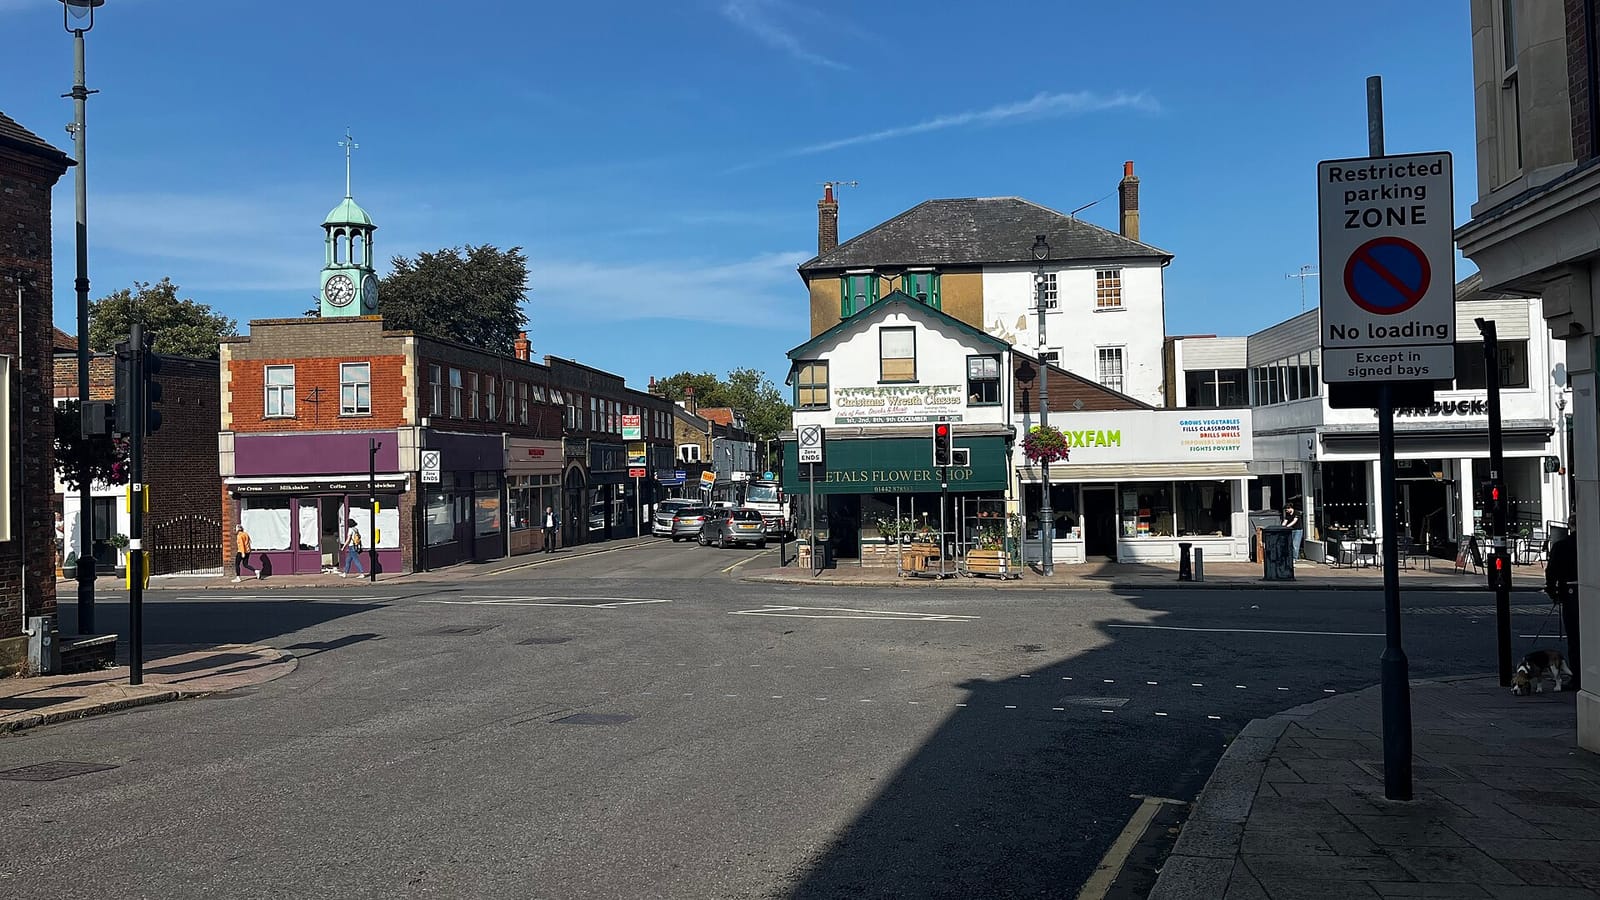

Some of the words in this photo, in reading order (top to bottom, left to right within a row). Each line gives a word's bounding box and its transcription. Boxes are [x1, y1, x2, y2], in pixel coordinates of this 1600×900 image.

[1328, 159, 1443, 183] Restricted
[1344, 184, 1426, 206] parking
[1344, 205, 1427, 230] ZONE
[1329, 324, 1360, 340] No
[1368, 321, 1448, 339] loading
[1356, 352, 1405, 363] Except
[1408, 351, 1421, 361] in
[1348, 365, 1393, 377] signed
[1397, 364, 1429, 376] bays
[836, 397, 885, 407] Christmas
[886, 395, 922, 406] Wreath
[924, 393, 961, 405] Classes
[1062, 430, 1121, 448] OXFAM
[826, 470, 868, 483] ETALS
[872, 469, 931, 482] FLOWER
